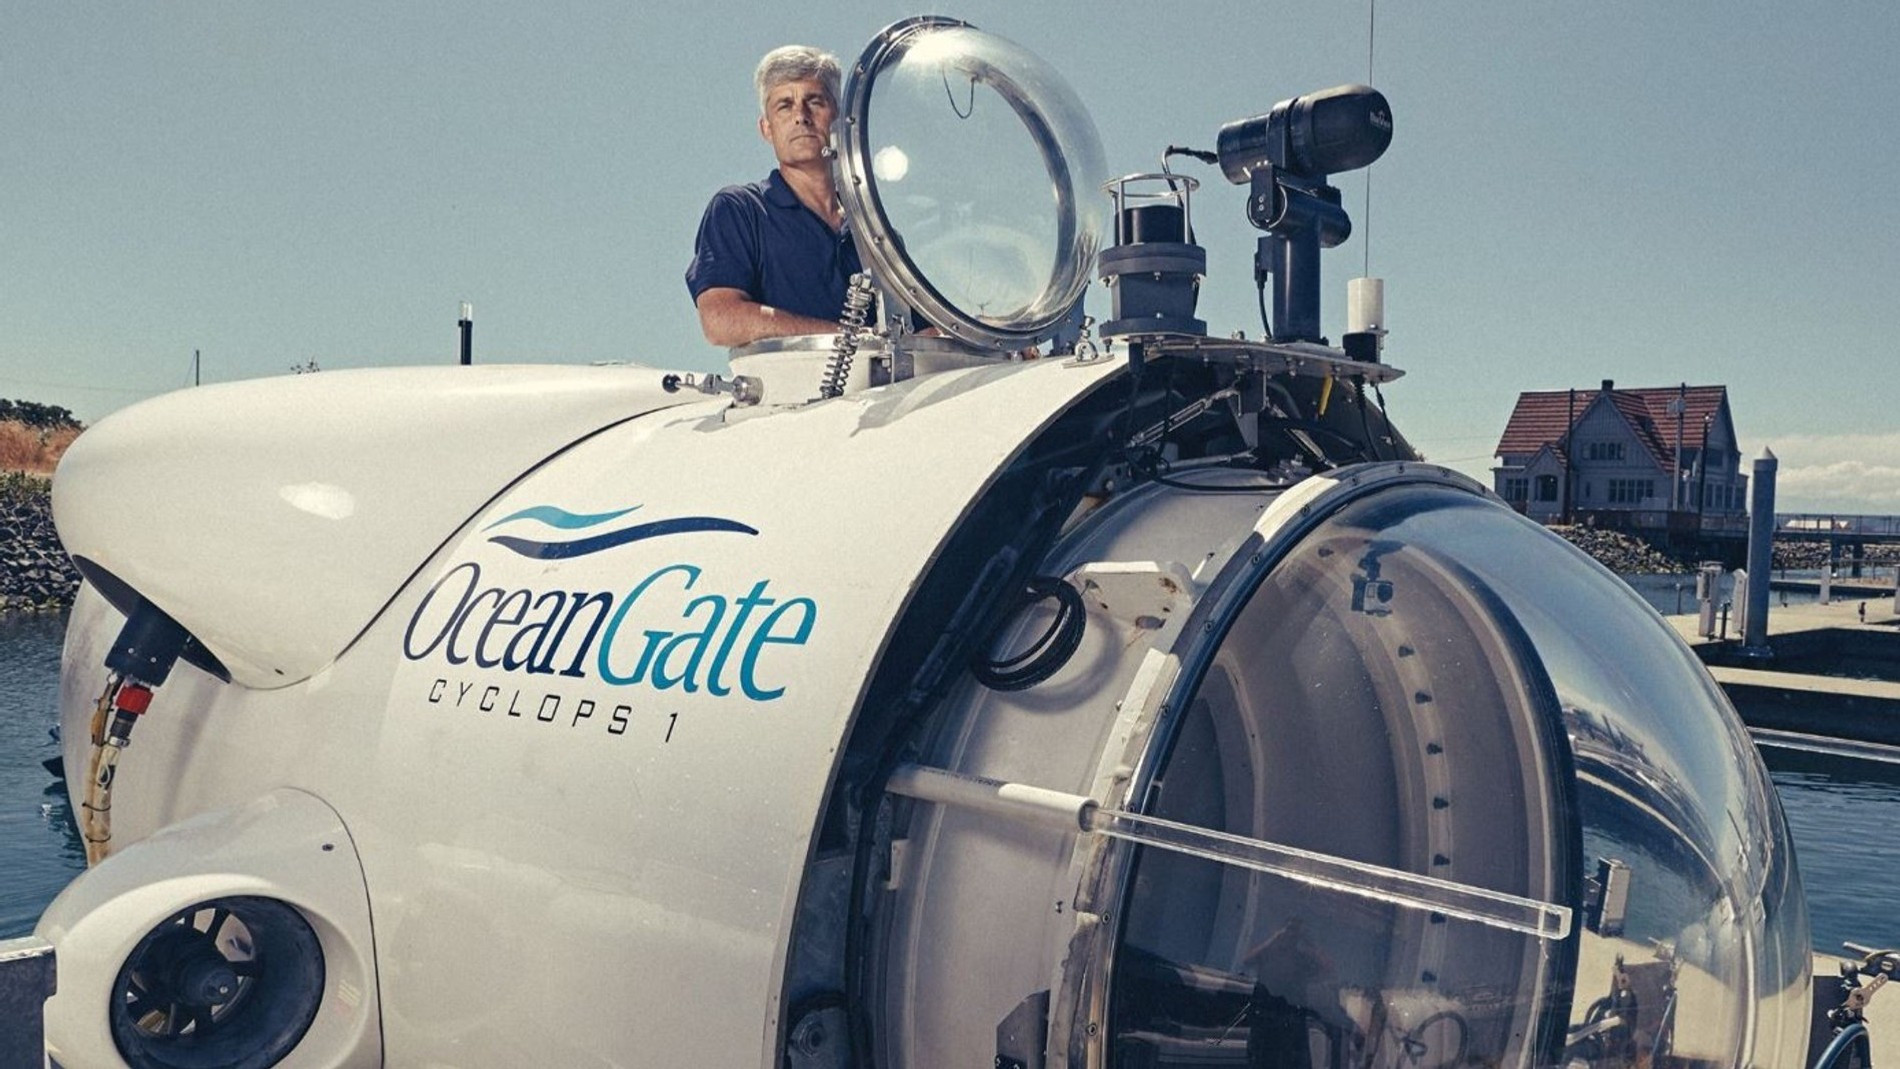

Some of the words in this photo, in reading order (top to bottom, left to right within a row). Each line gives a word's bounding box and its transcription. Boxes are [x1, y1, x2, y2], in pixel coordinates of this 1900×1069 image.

[403, 562, 817, 701] OceanGate
[428, 678, 632, 735] CYCLOPS
[665, 712, 679, 743] 1
